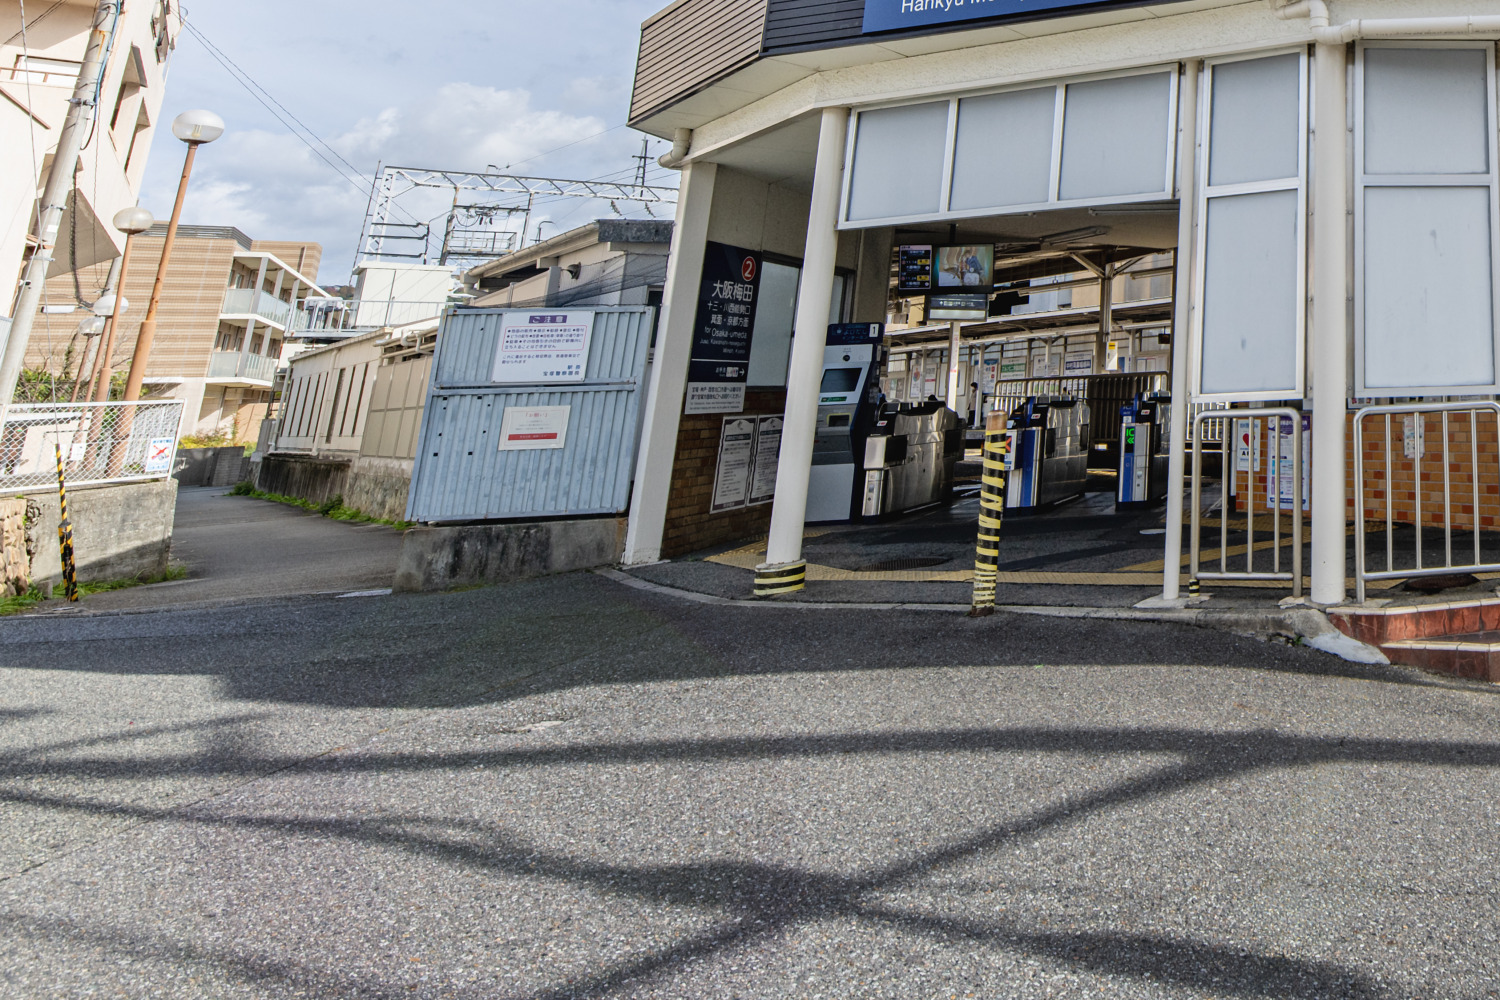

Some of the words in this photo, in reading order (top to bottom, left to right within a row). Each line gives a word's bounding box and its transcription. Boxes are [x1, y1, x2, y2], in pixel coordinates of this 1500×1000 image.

[744, 260, 752, 277] 2
[712, 280, 754, 302] 大阪梅田
[712, 328, 748, 339] Osaka-umeda
[1126, 428, 1135, 437] IC
